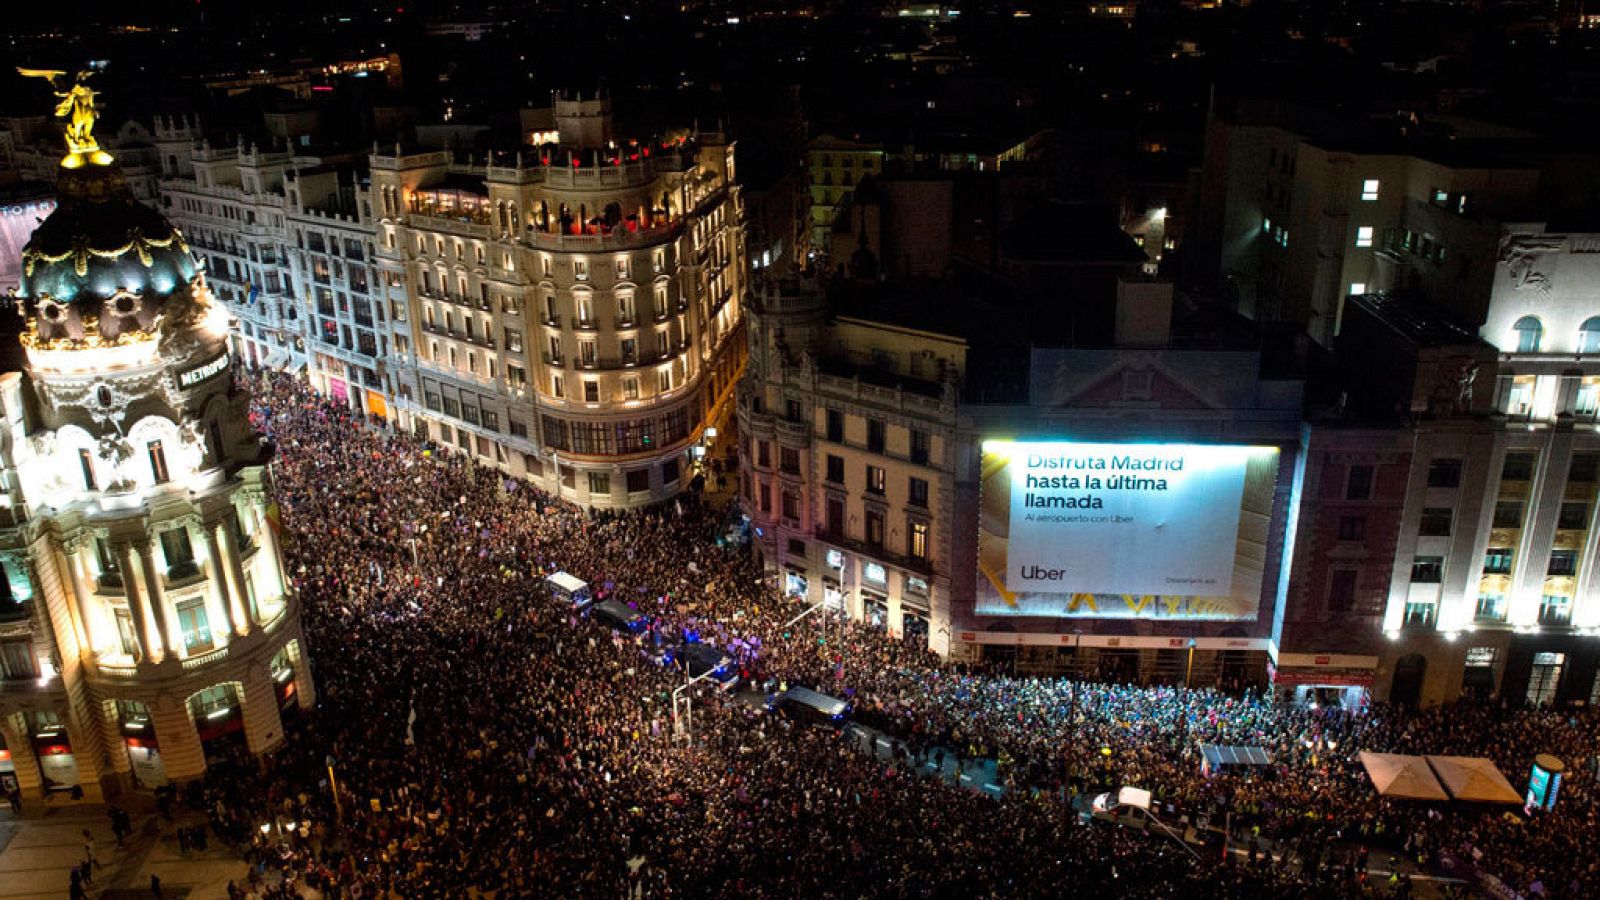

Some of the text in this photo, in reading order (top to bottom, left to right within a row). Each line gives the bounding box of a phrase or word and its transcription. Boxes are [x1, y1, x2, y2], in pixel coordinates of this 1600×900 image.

[1027, 453, 1184, 471] Disfruta Madrid
[1025, 473, 1168, 491] hasta la última
[1024, 493, 1104, 509] llamada
[1036, 514, 1089, 524] aeropuerto
[1090, 515, 1109, 523] con
[1110, 514, 1134, 524] Uber
[1021, 565, 1067, 580] Uber
